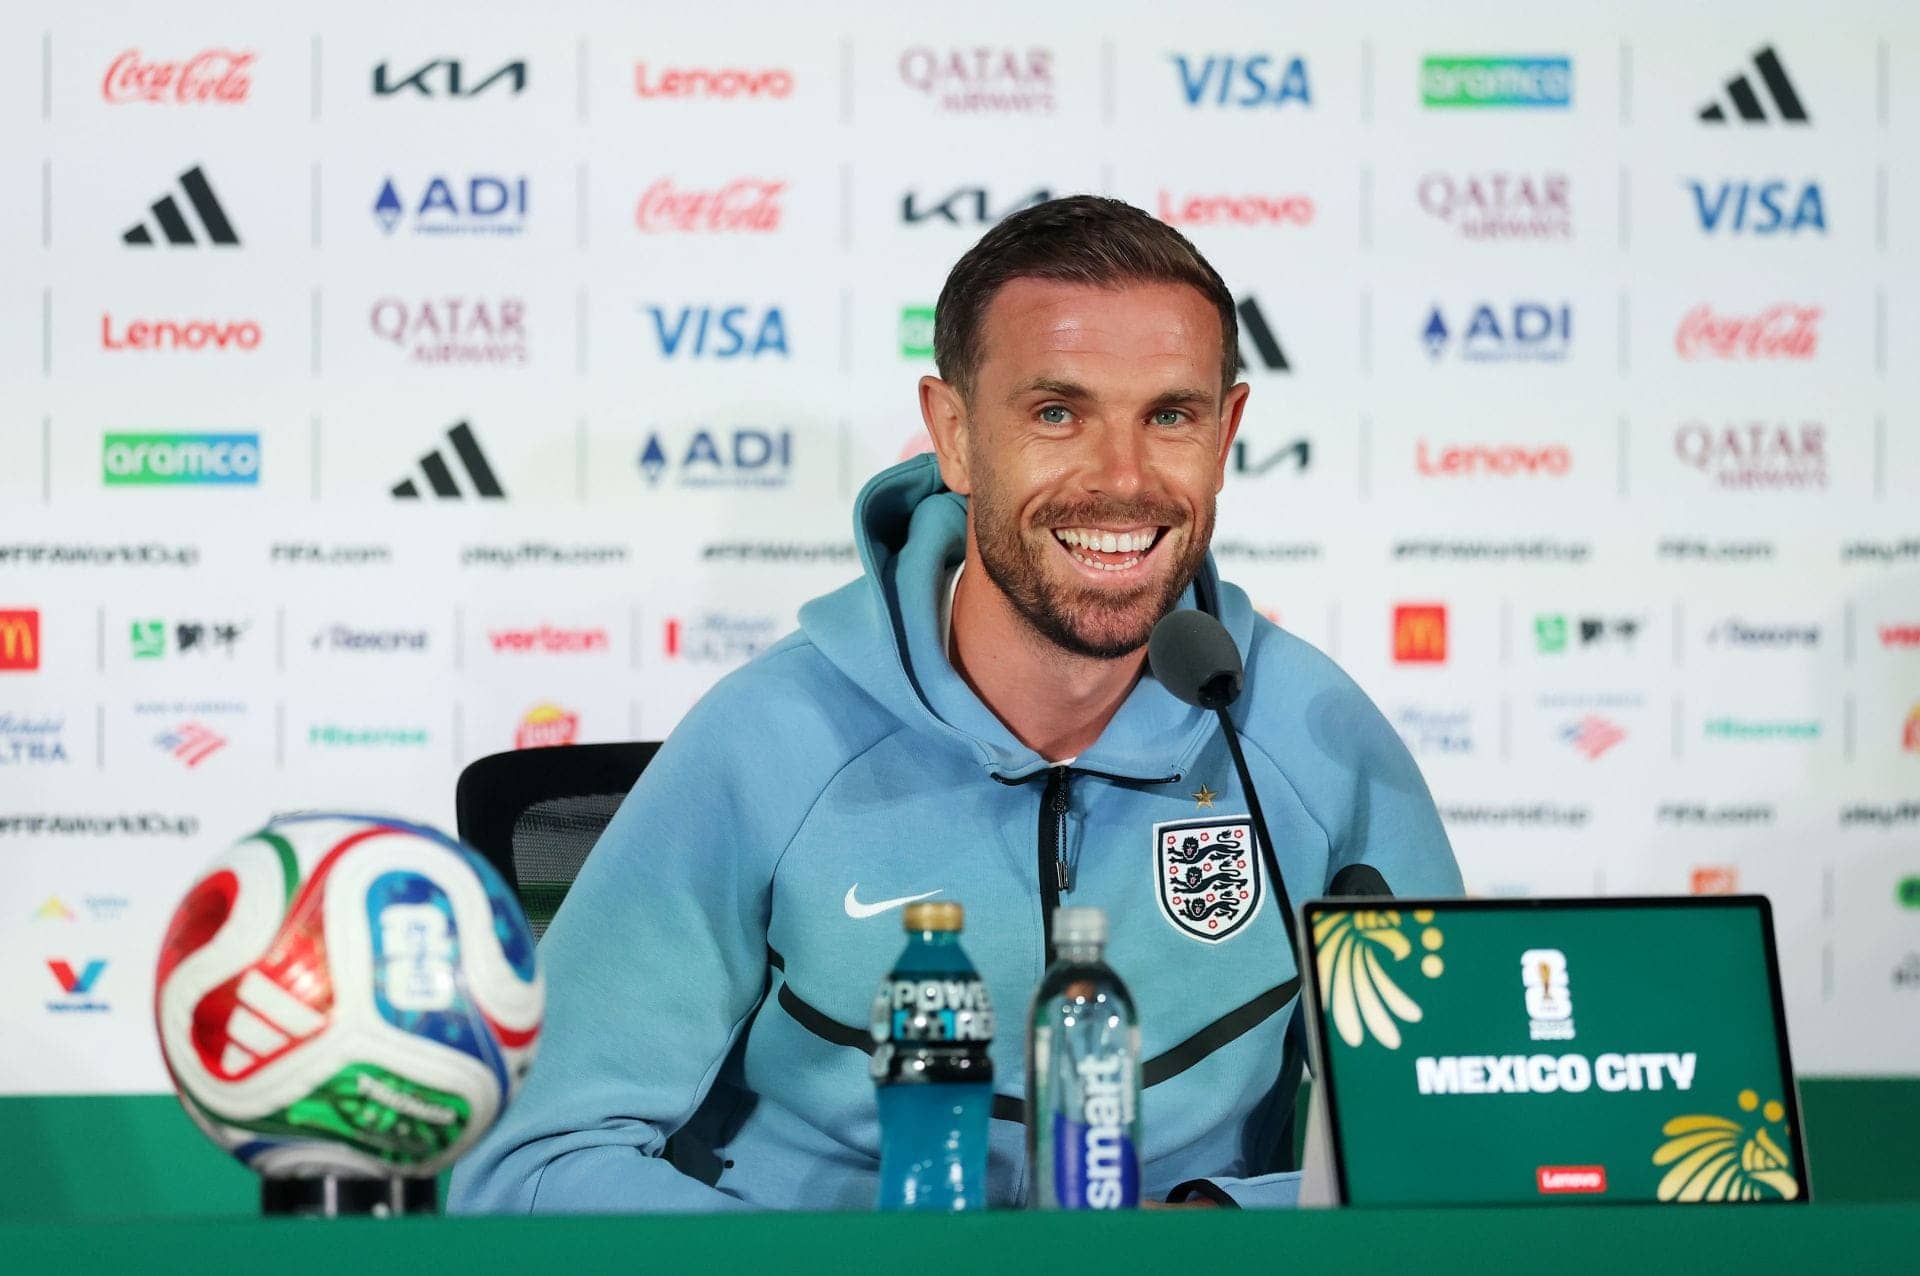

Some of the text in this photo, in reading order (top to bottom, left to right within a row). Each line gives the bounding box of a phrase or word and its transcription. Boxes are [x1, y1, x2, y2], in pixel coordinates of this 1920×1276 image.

[372, 59, 527, 97] KIA
[635, 61, 794, 99] Lenovo
[898, 45, 1054, 90] QATAR
[1174, 54, 1312, 108] VISA
[418, 176, 527, 215] ADI
[1158, 188, 1314, 226] Lenovo
[1417, 173, 1570, 218] QATAR
[1691, 180, 1828, 235] VISA
[101, 313, 262, 351] Lenovo
[370, 298, 525, 344] QATAR
[648, 305, 790, 359] VISA
[1464, 303, 1572, 343] ADI
[104, 441, 259, 477] aramco
[683, 430, 792, 468] ADI
[1416, 440, 1573, 476] Lenovo
[1675, 423, 1826, 470] QATAR
[1415, 1052, 1697, 1094] MEXICO CITY
[1076, 1053, 1122, 1209] smart
